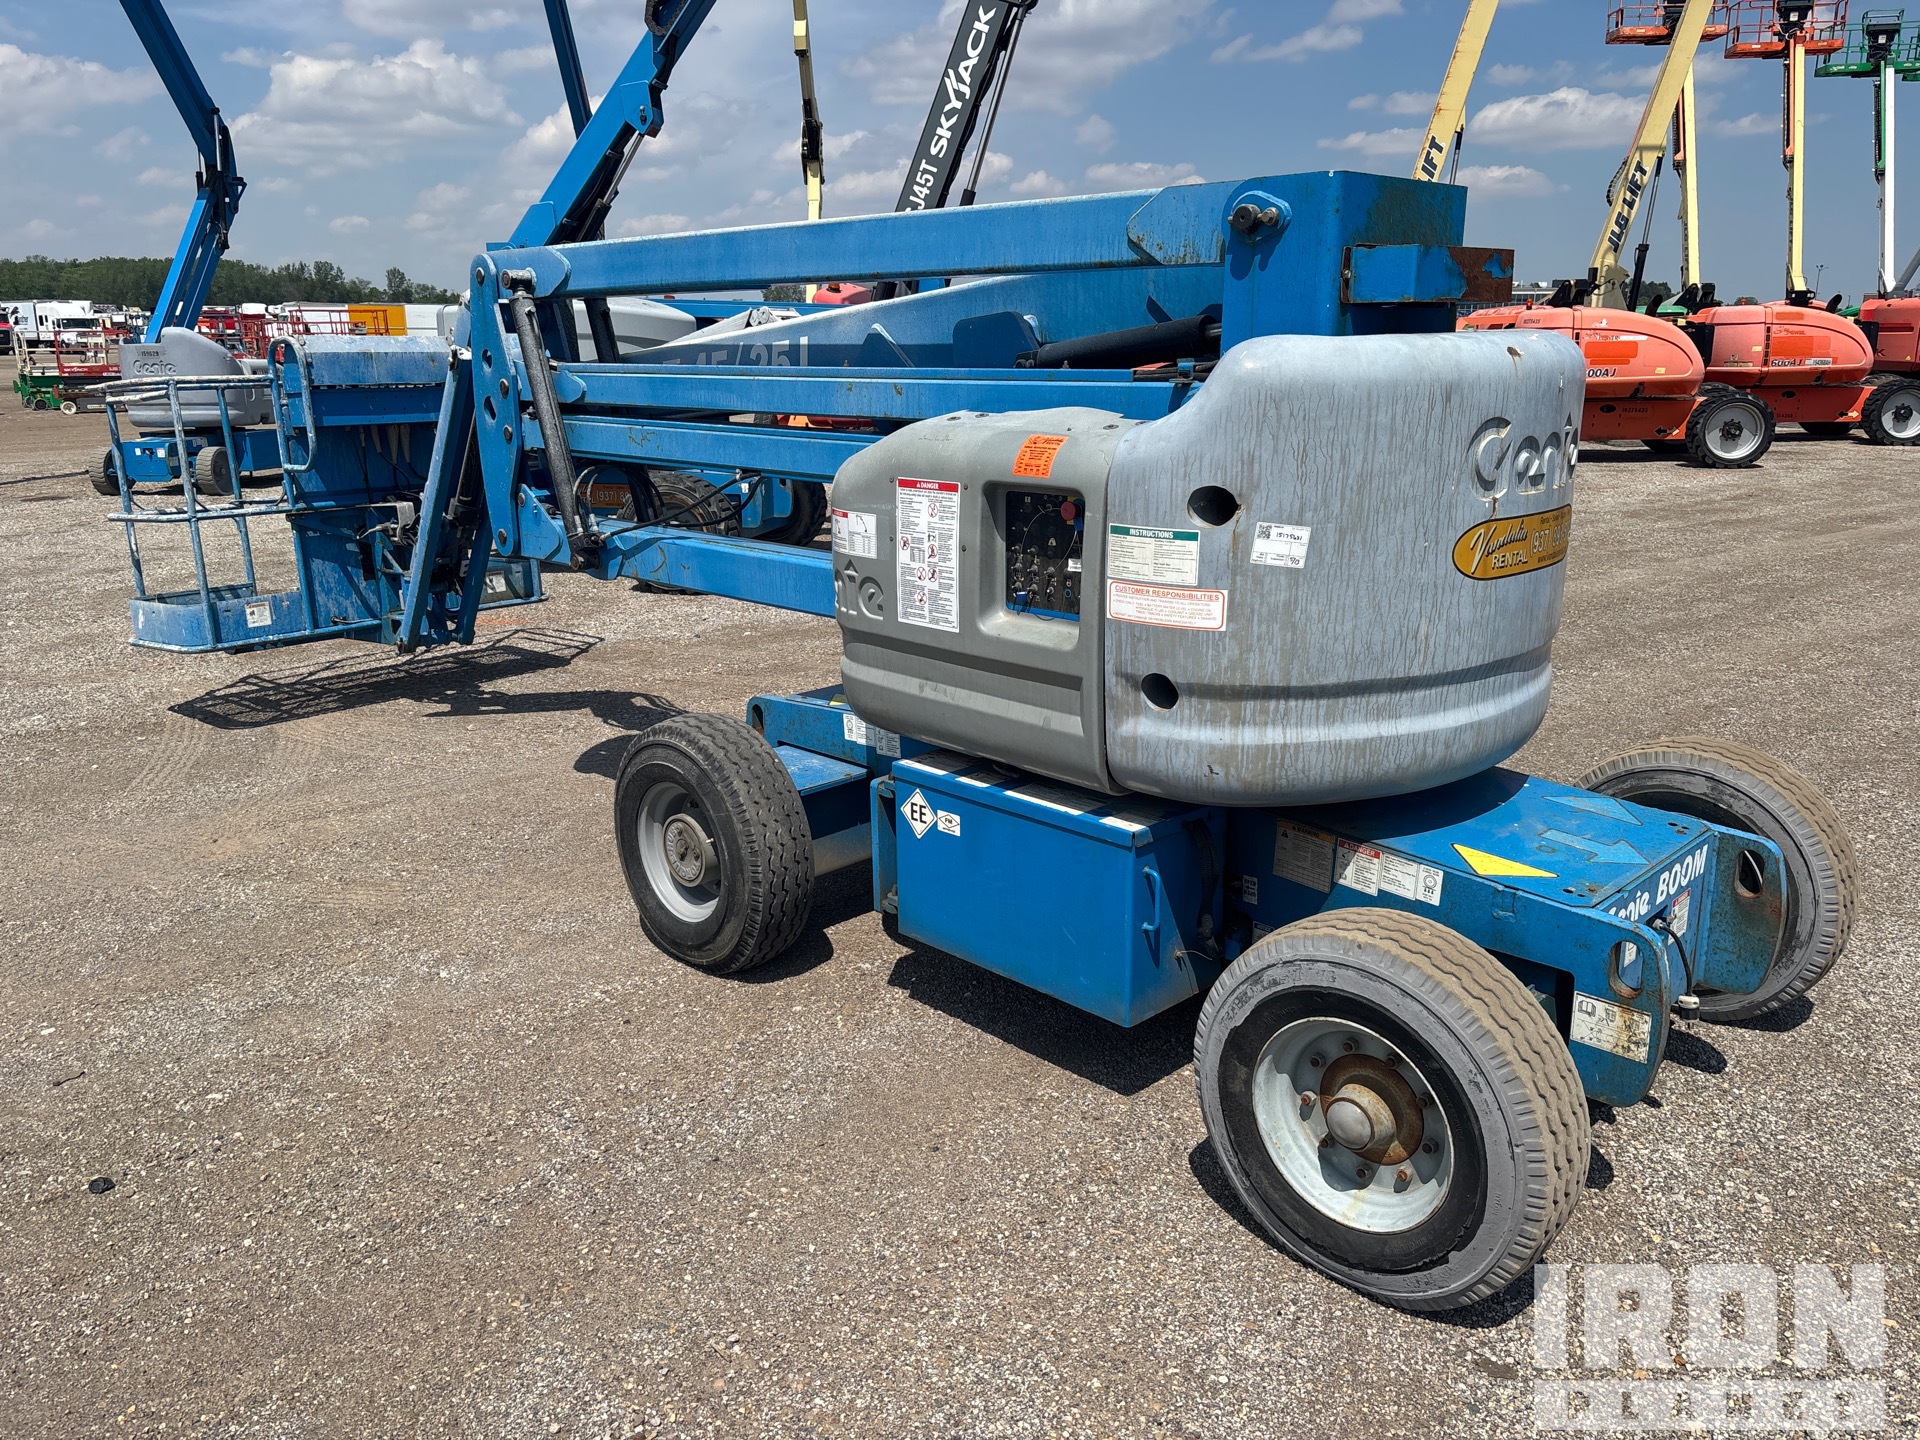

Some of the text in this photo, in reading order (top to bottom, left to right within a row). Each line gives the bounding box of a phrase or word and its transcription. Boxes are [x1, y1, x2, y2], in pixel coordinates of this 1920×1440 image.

[905, 5, 997, 212] J45T SKYJACK
[1415, 135, 1445, 182] IFT
[1607, 159, 1650, 254] JLG LIFT
[133, 360, 176, 375] Genie
[1584, 368, 1617, 378] 00AJ
[596, 490, 618, 502] (937)
[920, 482, 939, 490] DANGER
[1129, 528, 1174, 539] INSTRUCTIONS
[1469, 519, 1528, 576] Vandalia
[1491, 549, 1529, 570] RENTAL
[834, 558, 885, 621] nie
[1114, 584, 1220, 601] CUSTOMER RESPONSIBILITIES
[910, 801, 928, 825] EE
[1349, 843, 1376, 857] DANGER
[1655, 843, 1709, 906] BOOM
